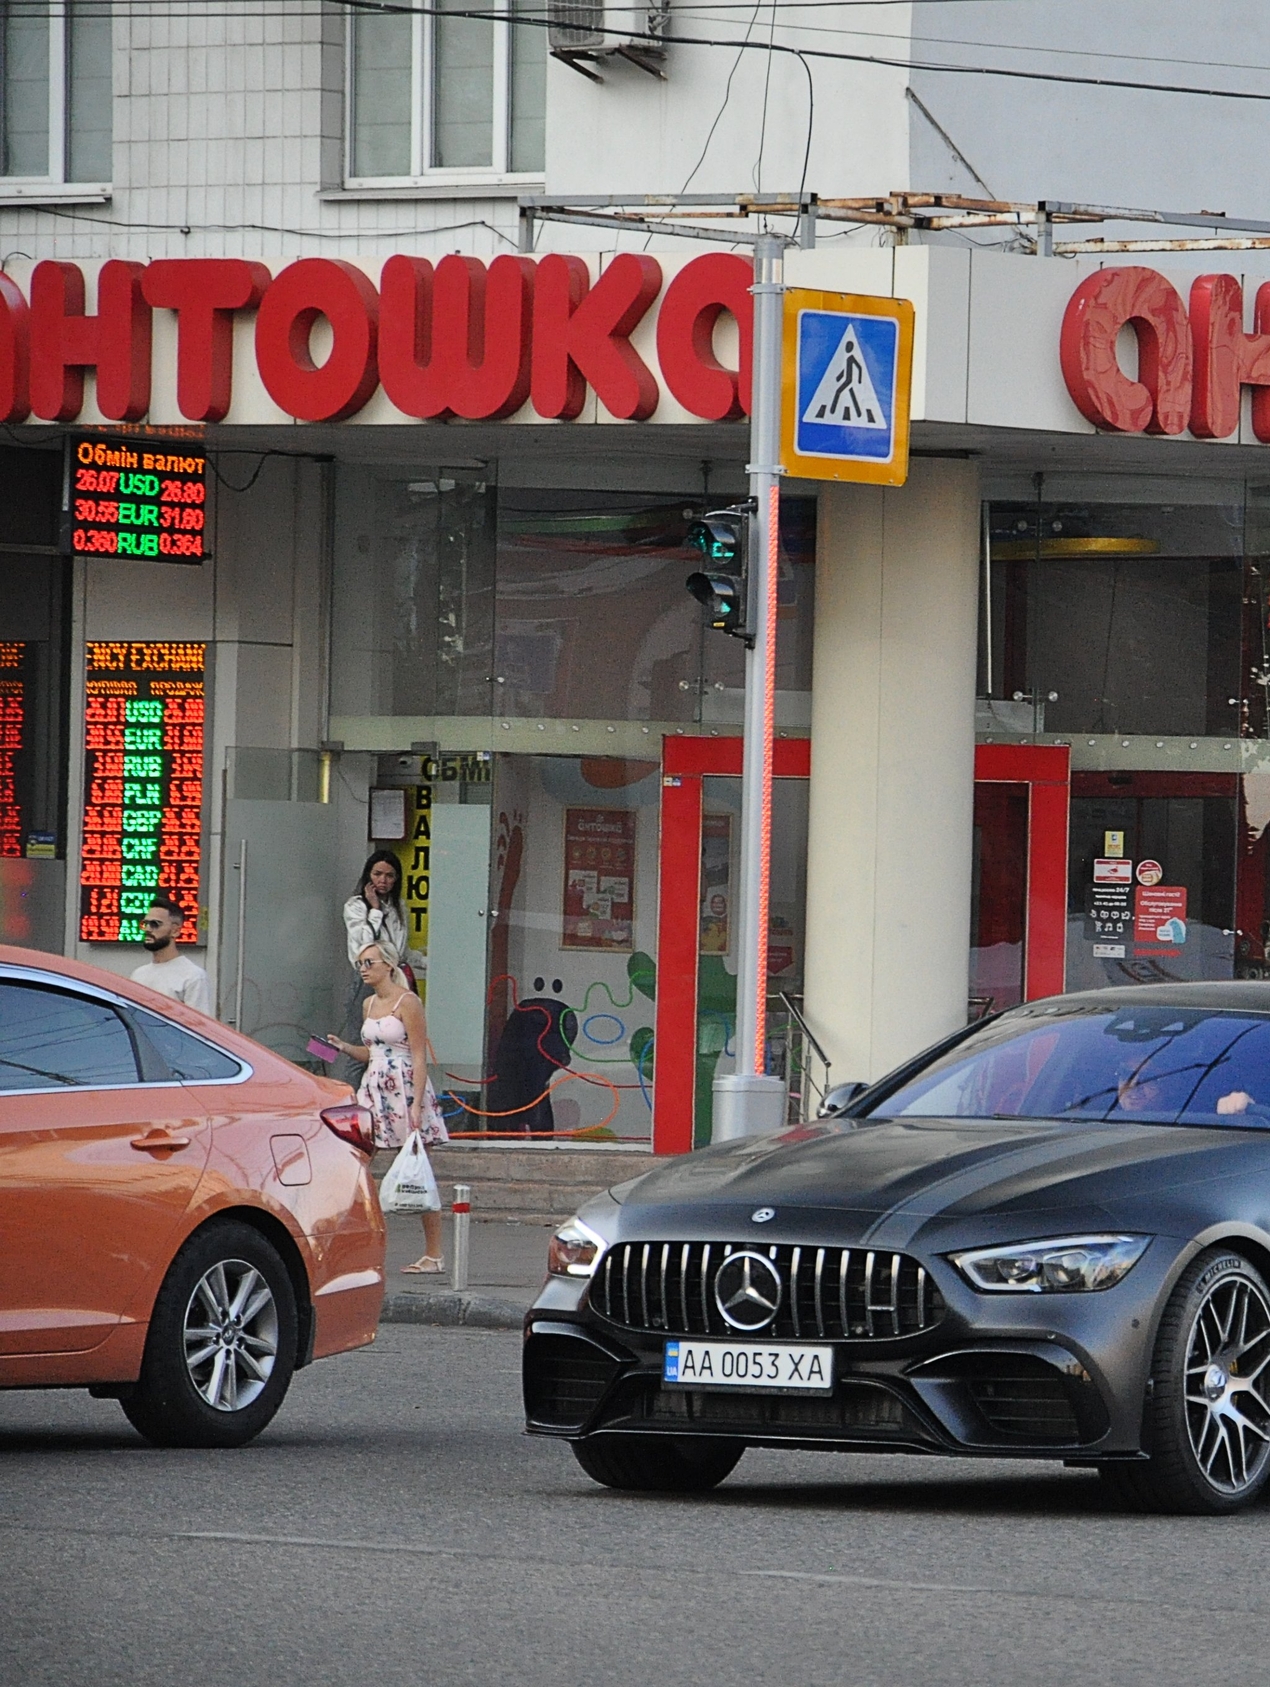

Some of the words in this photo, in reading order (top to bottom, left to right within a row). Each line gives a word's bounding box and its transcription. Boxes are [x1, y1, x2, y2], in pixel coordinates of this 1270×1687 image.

[78, 442, 138, 469] Обмін
[142, 453, 205, 474] валют
[75, 468, 120, 493] 26.07
[119, 472, 160, 496] USD
[118, 502, 160, 527] EUR
[117, 532, 159, 556] RUB
[125, 700, 163, 723] USD
[124, 728, 162, 751] EUR
[406, 784, 432, 932] ВАЛЮТ
[666, 1366, 678, 1377] UA
[681, 1349, 714, 1378] AA
[721, 1351, 780, 1379] 0053
[788, 1353, 824, 1382] XA
